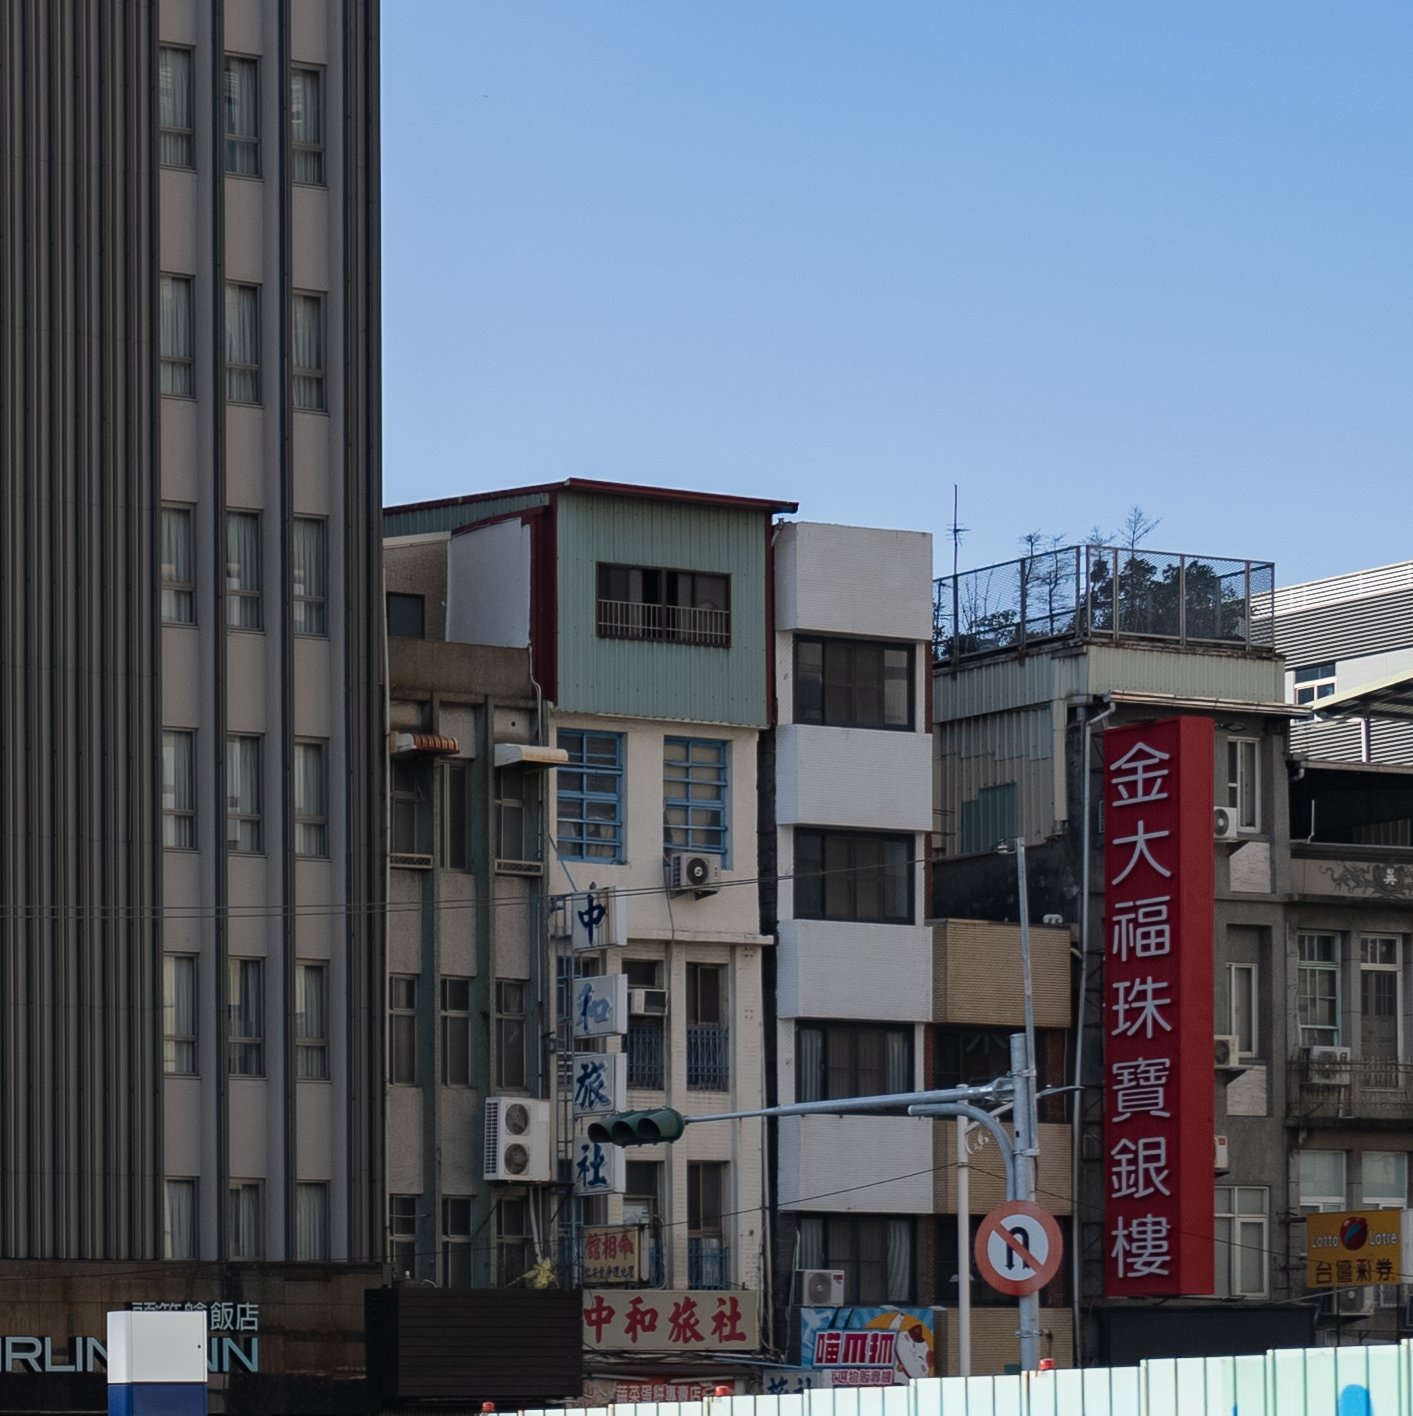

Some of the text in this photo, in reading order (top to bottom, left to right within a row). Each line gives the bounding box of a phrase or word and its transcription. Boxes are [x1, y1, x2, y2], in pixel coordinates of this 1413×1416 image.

[575, 881, 611, 1189] 中和旅社
[1110, 741, 1172, 1279] 金大福珠寶銀樓
[582, 1295, 747, 1345] 中和旅社
[1311, 1233, 1339, 1248] Lotto
